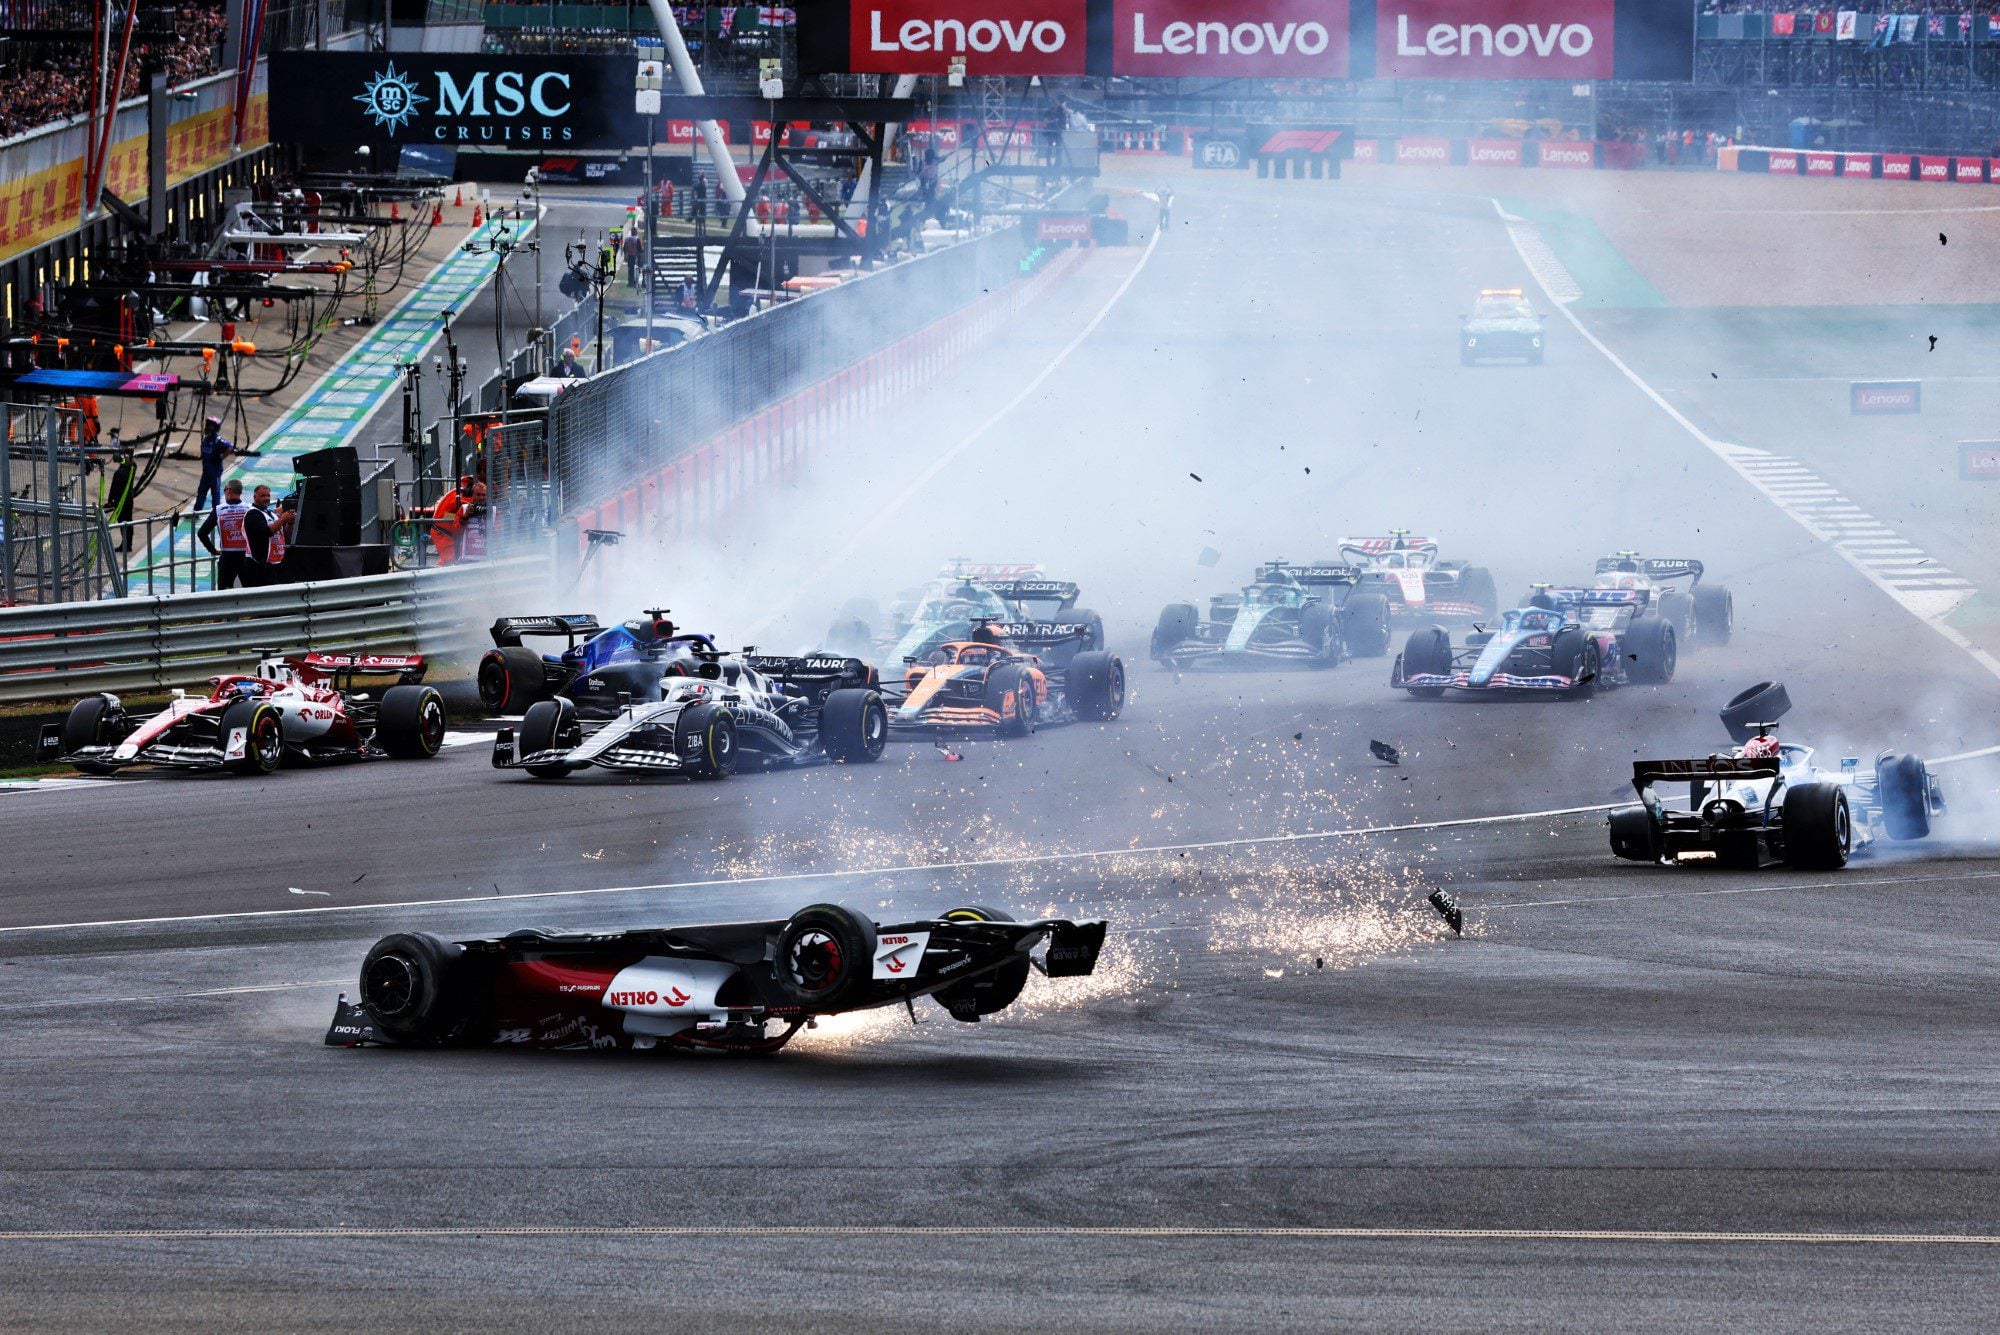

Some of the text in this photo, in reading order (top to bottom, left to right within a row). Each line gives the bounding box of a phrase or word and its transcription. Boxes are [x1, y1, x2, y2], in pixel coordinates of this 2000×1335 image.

[870, 10, 1066, 53] Lenovo
[1134, 12, 1330, 56] Lenovo
[1397, 14, 1594, 57] Lenovo
[434, 71, 571, 117] MSC
[434, 125, 573, 140] CRUISES
[1204, 151, 1236, 163] FIA
[1399, 145, 1446, 159] Lenovo
[1471, 147, 1517, 161] Lenovo
[1543, 149, 1590, 163] Lenovo
[1770, 157, 1797, 170] Lenovo
[1807, 157, 1833, 171] Lenovo
[1845, 158, 1871, 173] Lenovo
[1883, 161, 1910, 175] Lenovo
[1921, 163, 1947, 176] Lenovo
[1957, 164, 1982, 178] Lenovo
[1042, 224, 1088, 234] Lenovo
[1861, 394, 1911, 405] Lenovo
[1651, 560, 1690, 568] TAURI
[806, 659, 846, 668] TAURI
[314, 710, 334, 720] ORLEN
[687, 734, 704, 748] ZIBA
[1661, 759, 1755, 776] INEOS
[881, 935, 909, 946] ORLEN
[610, 990, 658, 1006] ORLEN
[334, 1025, 361, 1034] FLOKI
